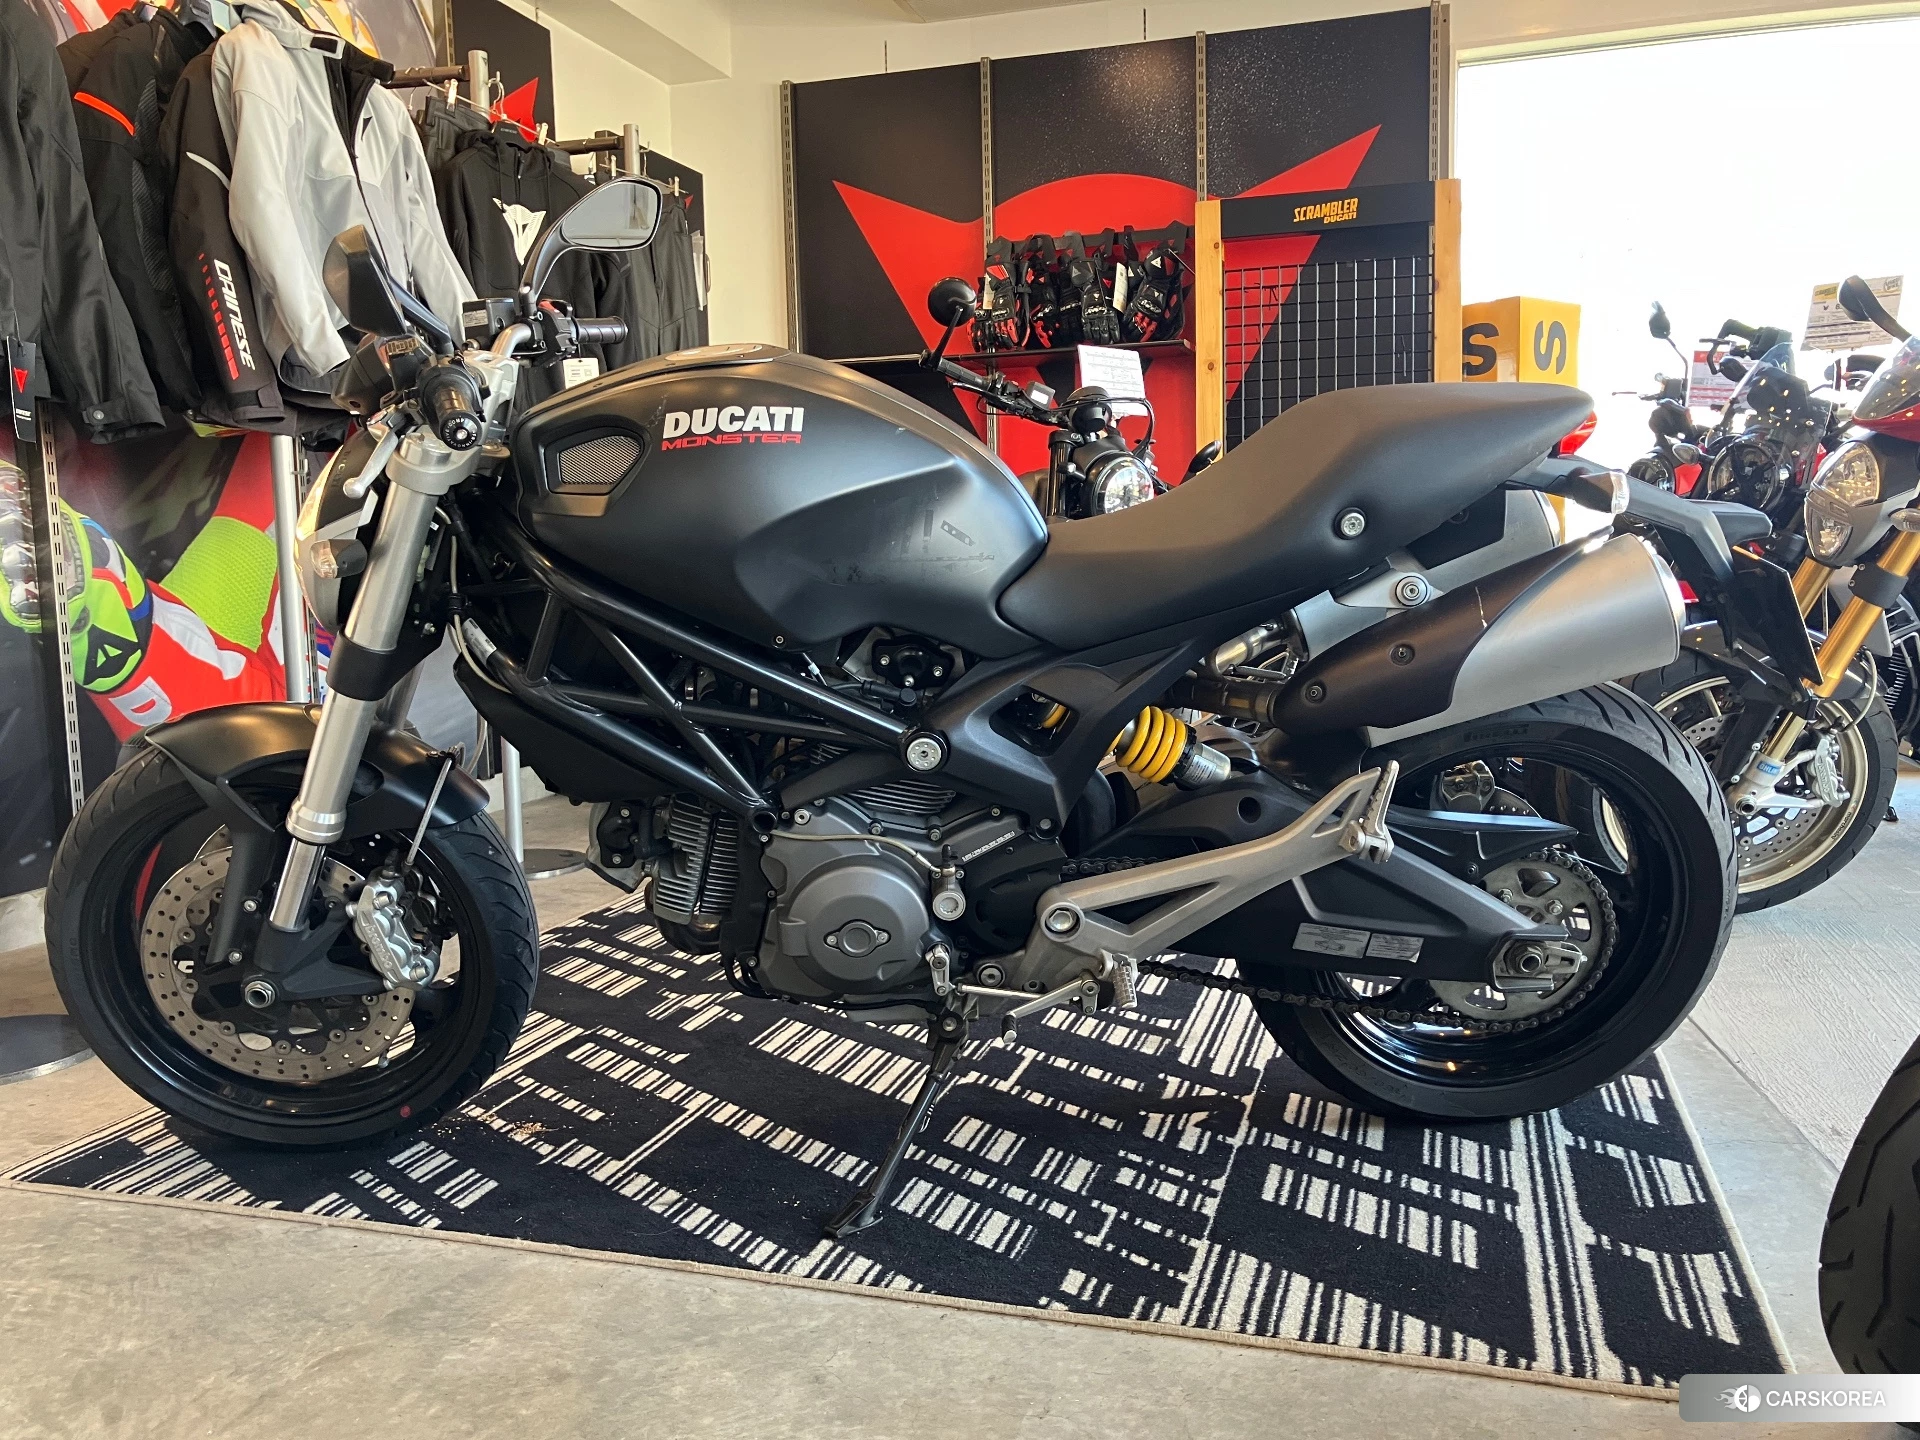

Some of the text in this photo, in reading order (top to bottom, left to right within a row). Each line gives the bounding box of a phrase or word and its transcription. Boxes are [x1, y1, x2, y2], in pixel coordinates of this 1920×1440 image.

[1293, 198, 1358, 222] SCRAMBLER
[1323, 212, 1357, 224] DUCATI
[214, 259, 255, 370] DAINESE
[1534, 321, 1566, 374] S
[663, 405, 804, 439] DUCATI
[661, 433, 801, 450] MONSTER
[365, 925, 392, 968] brembo
